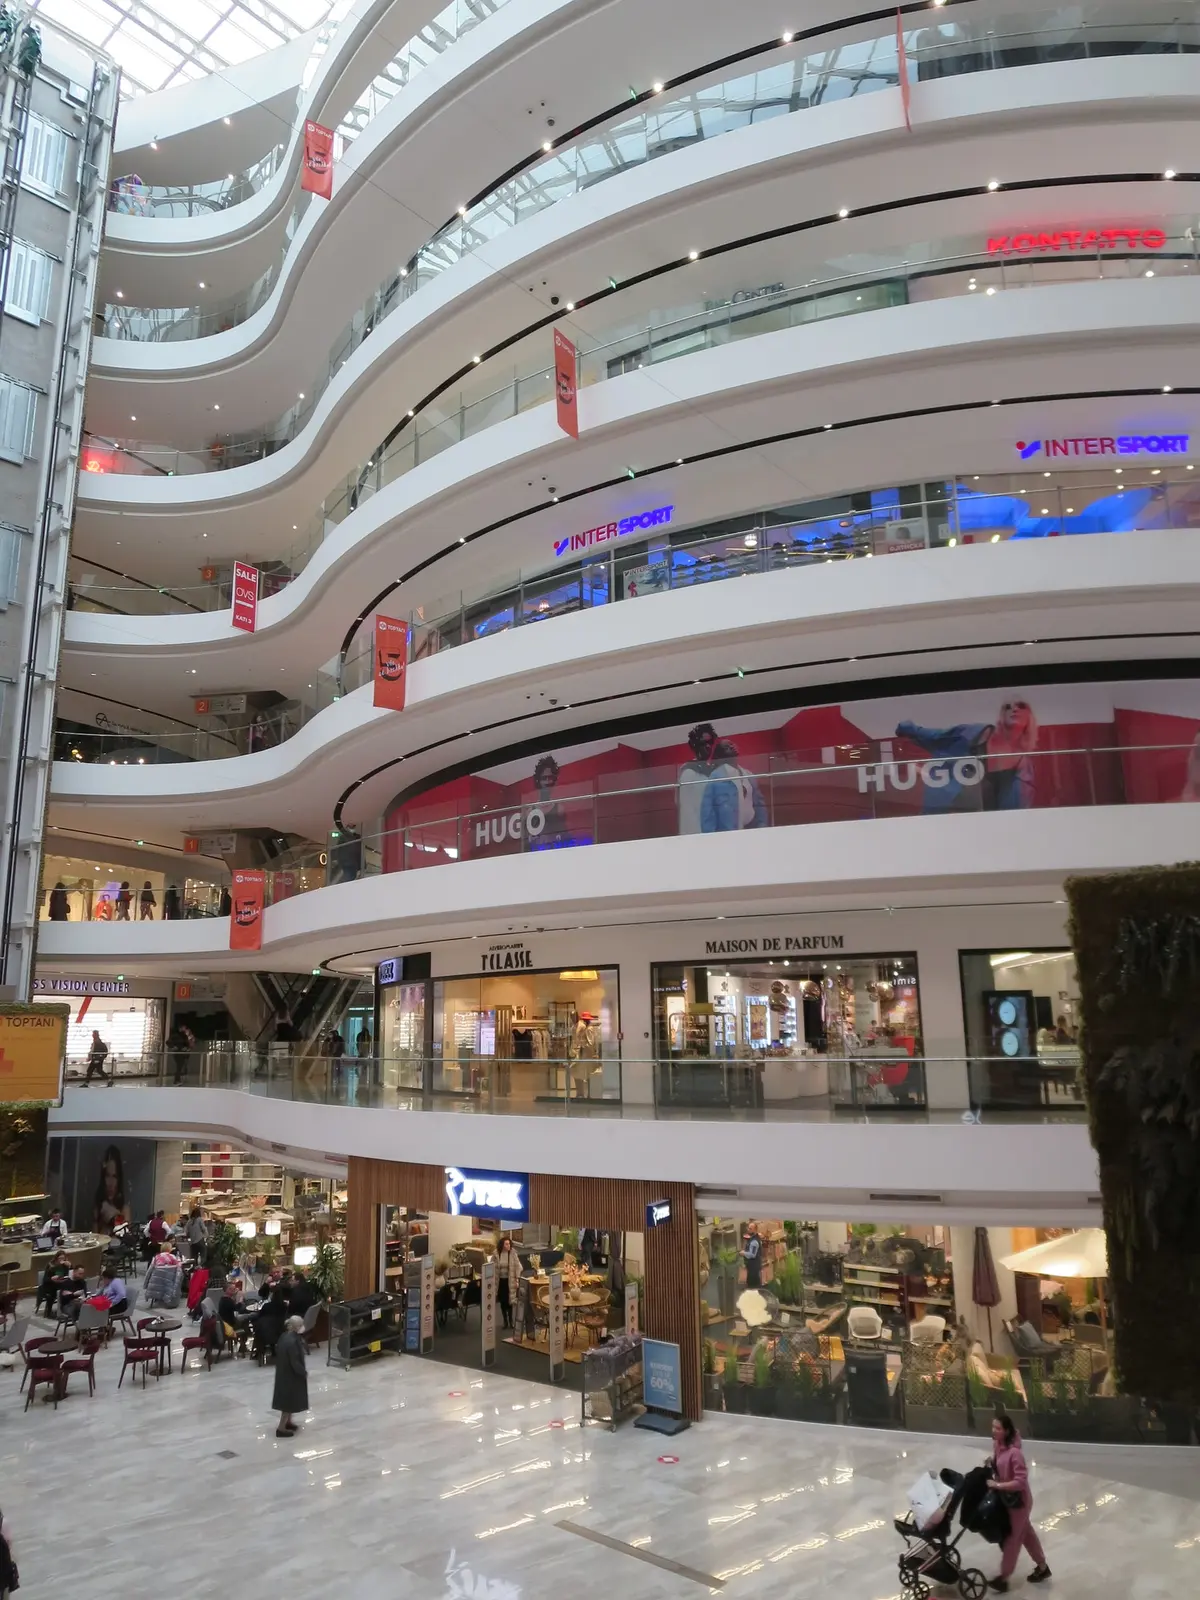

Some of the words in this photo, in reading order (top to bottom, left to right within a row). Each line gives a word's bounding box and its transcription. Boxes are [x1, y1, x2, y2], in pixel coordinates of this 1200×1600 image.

[987, 228, 1167, 257] KONTATTO
[1044, 434, 1189, 457] INTERSPORT
[570, 505, 674, 551] INTERSPORT
[236, 568, 257, 583] SALE
[236, 587, 254, 601] OVS
[198, 702, 205, 711] 2
[857, 758, 985, 794] HUGO
[475, 808, 545, 847] HUGO
[188, 841, 194, 849] 1
[705, 939, 758, 954] MAISON
[762, 937, 781, 951] DE
[785, 935, 845, 950] PARFUM
[51, 979, 89, 991] VISION
[92, 981, 130, 993] CENTER
[6, 1017, 55, 1028] TOPTANI
[459, 1178, 523, 1210] JYSK
